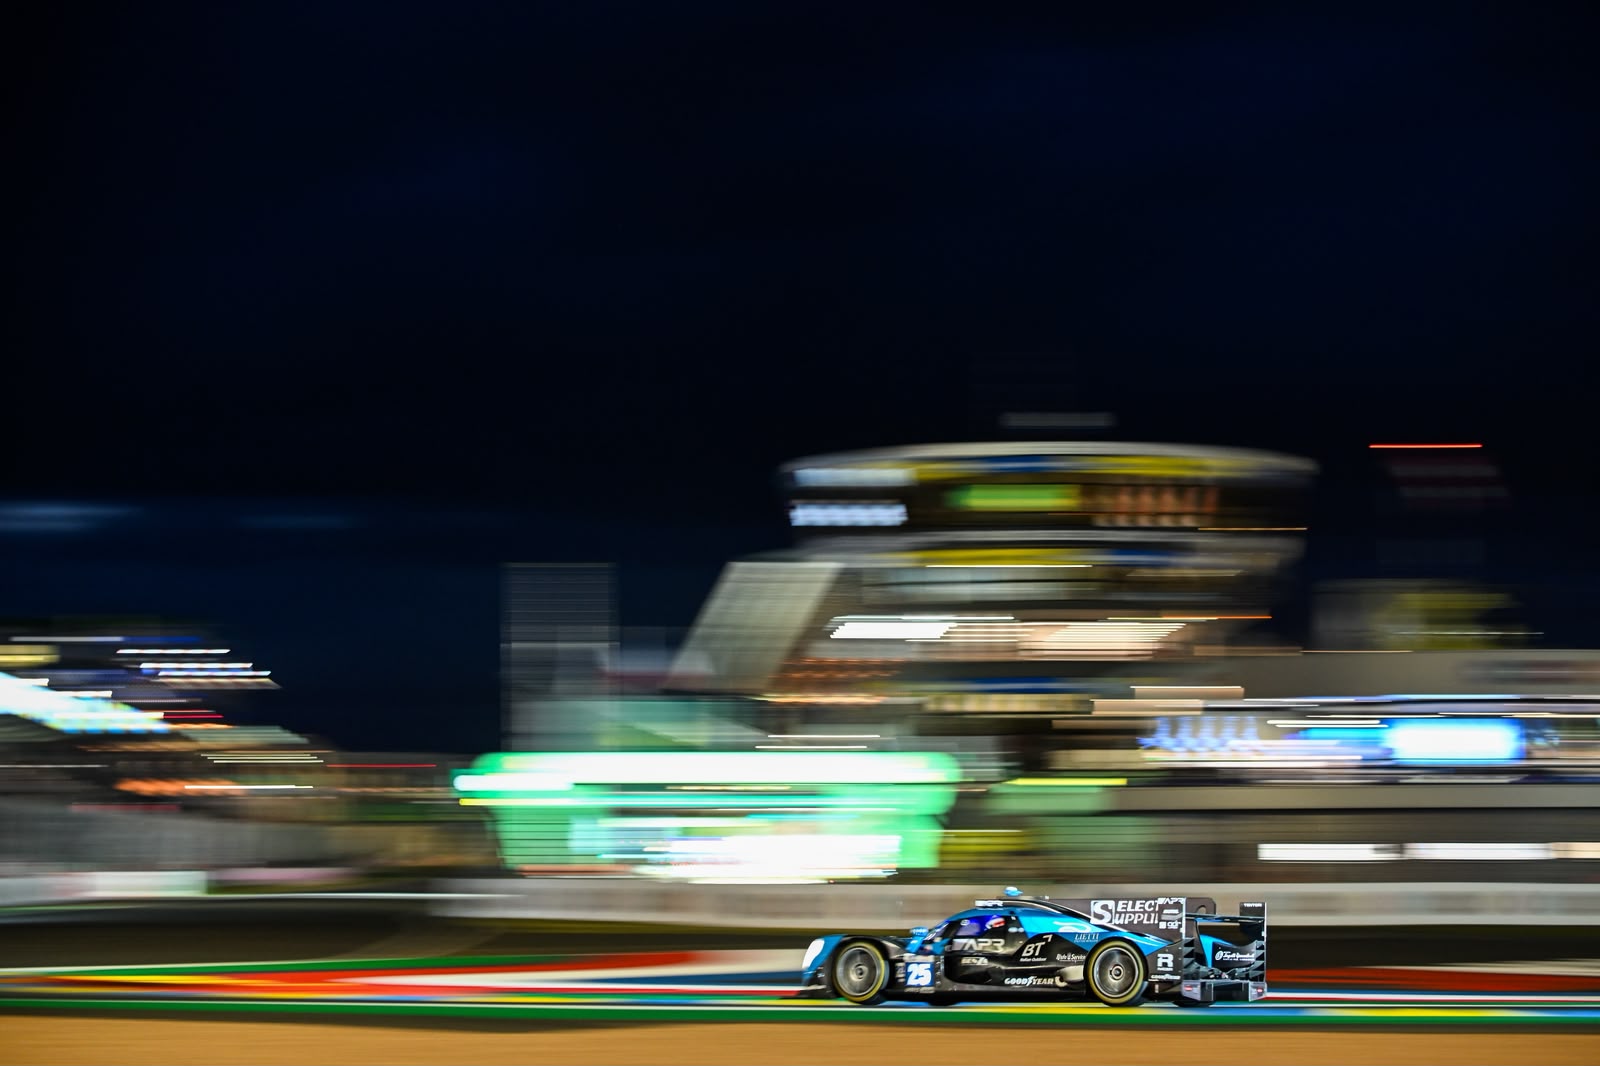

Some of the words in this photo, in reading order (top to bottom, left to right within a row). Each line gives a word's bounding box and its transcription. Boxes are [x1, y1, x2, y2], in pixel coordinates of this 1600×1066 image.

[1022, 941, 1046, 956] BT
[907, 963, 932, 986] 25
[1004, 975, 1054, 986] GOODYEAR
